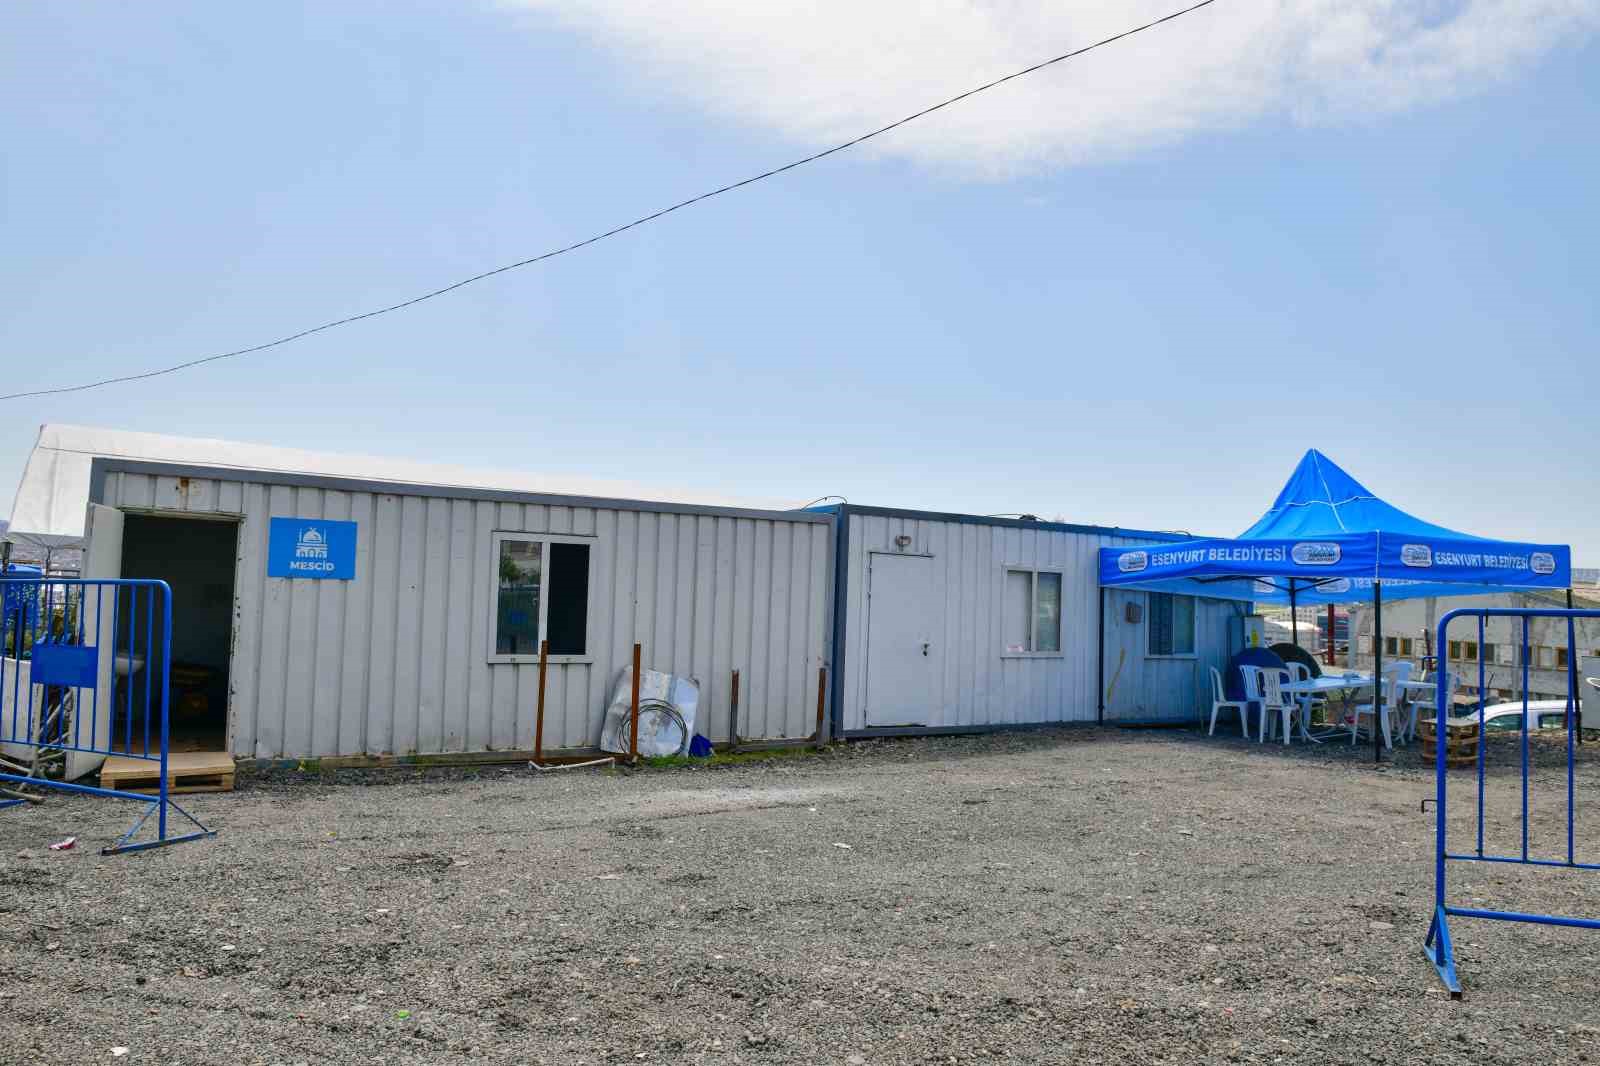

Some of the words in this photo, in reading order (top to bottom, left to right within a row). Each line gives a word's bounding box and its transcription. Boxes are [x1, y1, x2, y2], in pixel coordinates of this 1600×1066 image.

[1151, 549, 1207, 567] ESENYURT
[1208, 544, 1287, 562] BELEDİYESİ
[1434, 552, 1482, 568] ESENYURT
[1483, 552, 1529, 569] BELEDİYESİ
[289, 559, 335, 571] MESCİD
